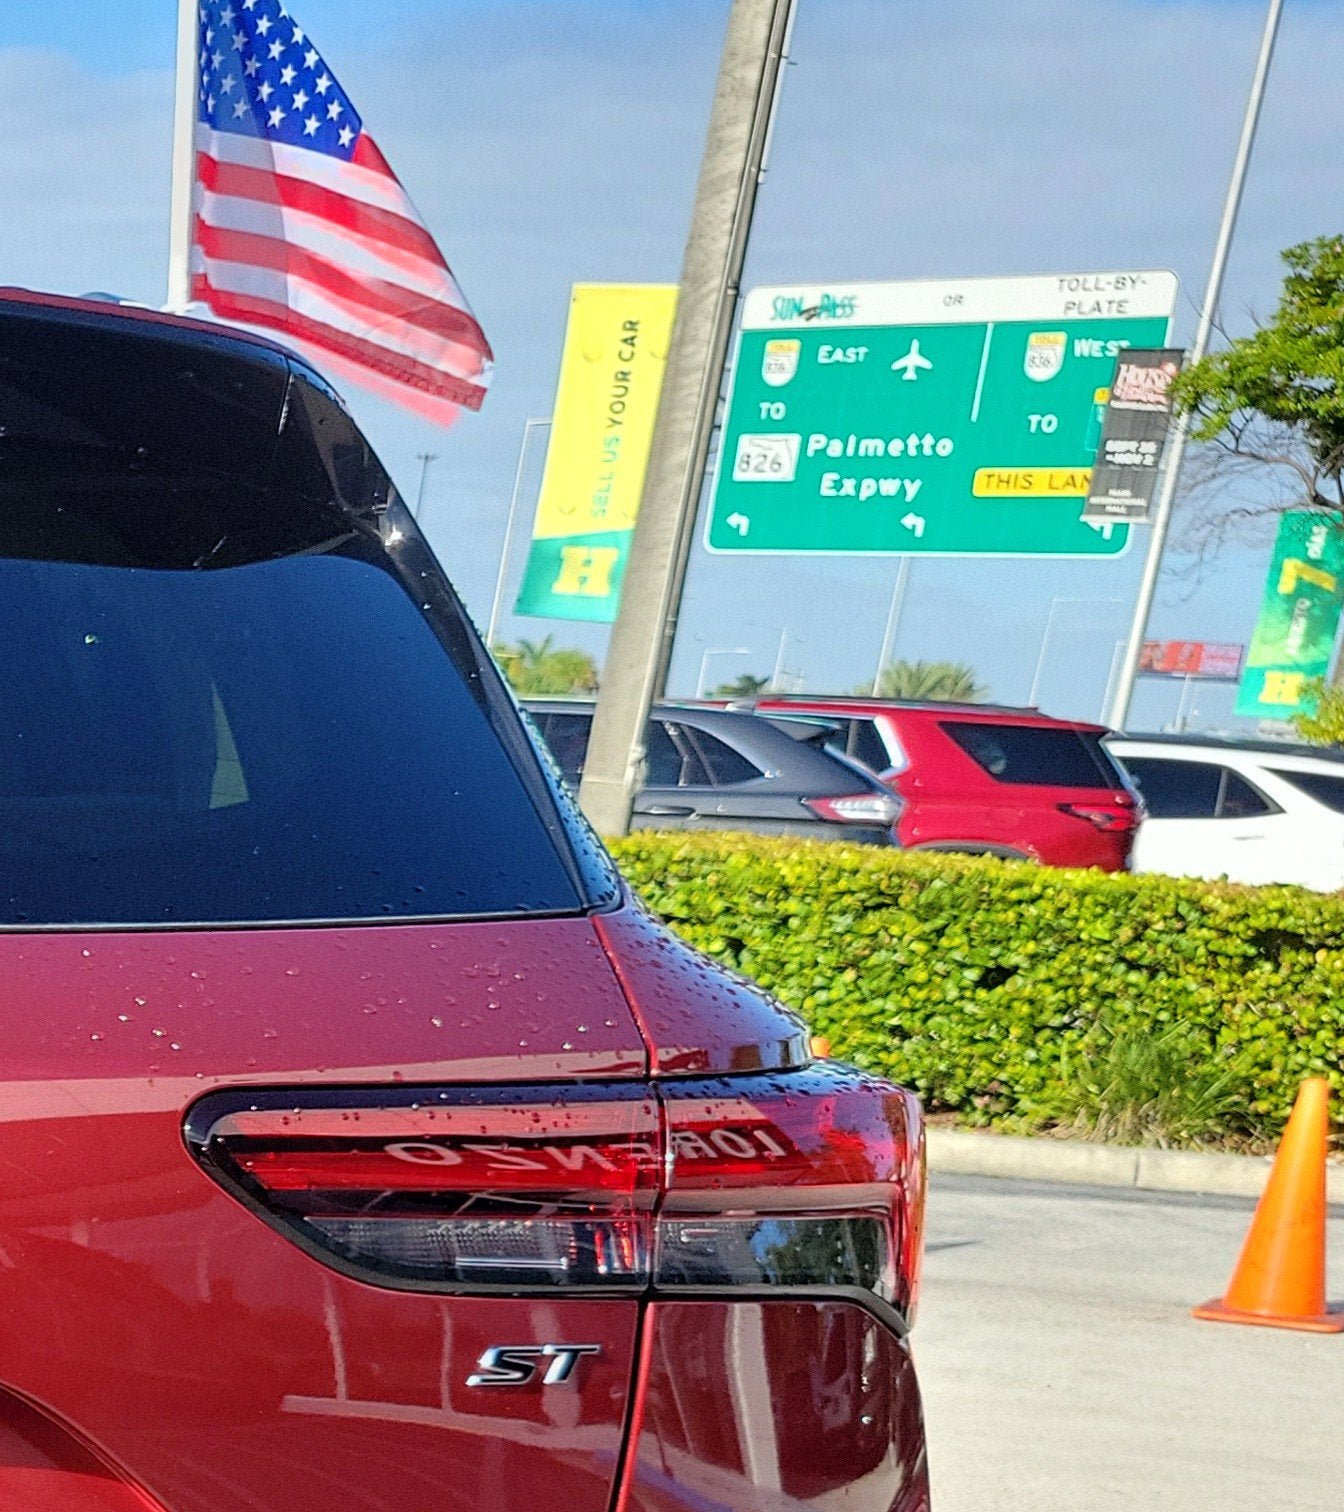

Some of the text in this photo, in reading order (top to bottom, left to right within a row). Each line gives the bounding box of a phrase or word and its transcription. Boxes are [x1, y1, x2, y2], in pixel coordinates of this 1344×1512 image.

[943, 294, 964, 307] OR
[1063, 299, 1129, 316] PLATE
[817, 345, 869, 364] EAST
[1028, 354, 1052, 369] 836
[591, 320, 640, 518] SELL US YOUR CAR
[759, 402, 787, 420] TO
[1027, 414, 1058, 433] TO
[806, 433, 954, 457] Palmetto
[738, 453, 782, 472] 826
[820, 472, 923, 503] Expwy
[985, 474, 1092, 490] THIS LAN
[465, 1343, 602, 1387] ST
